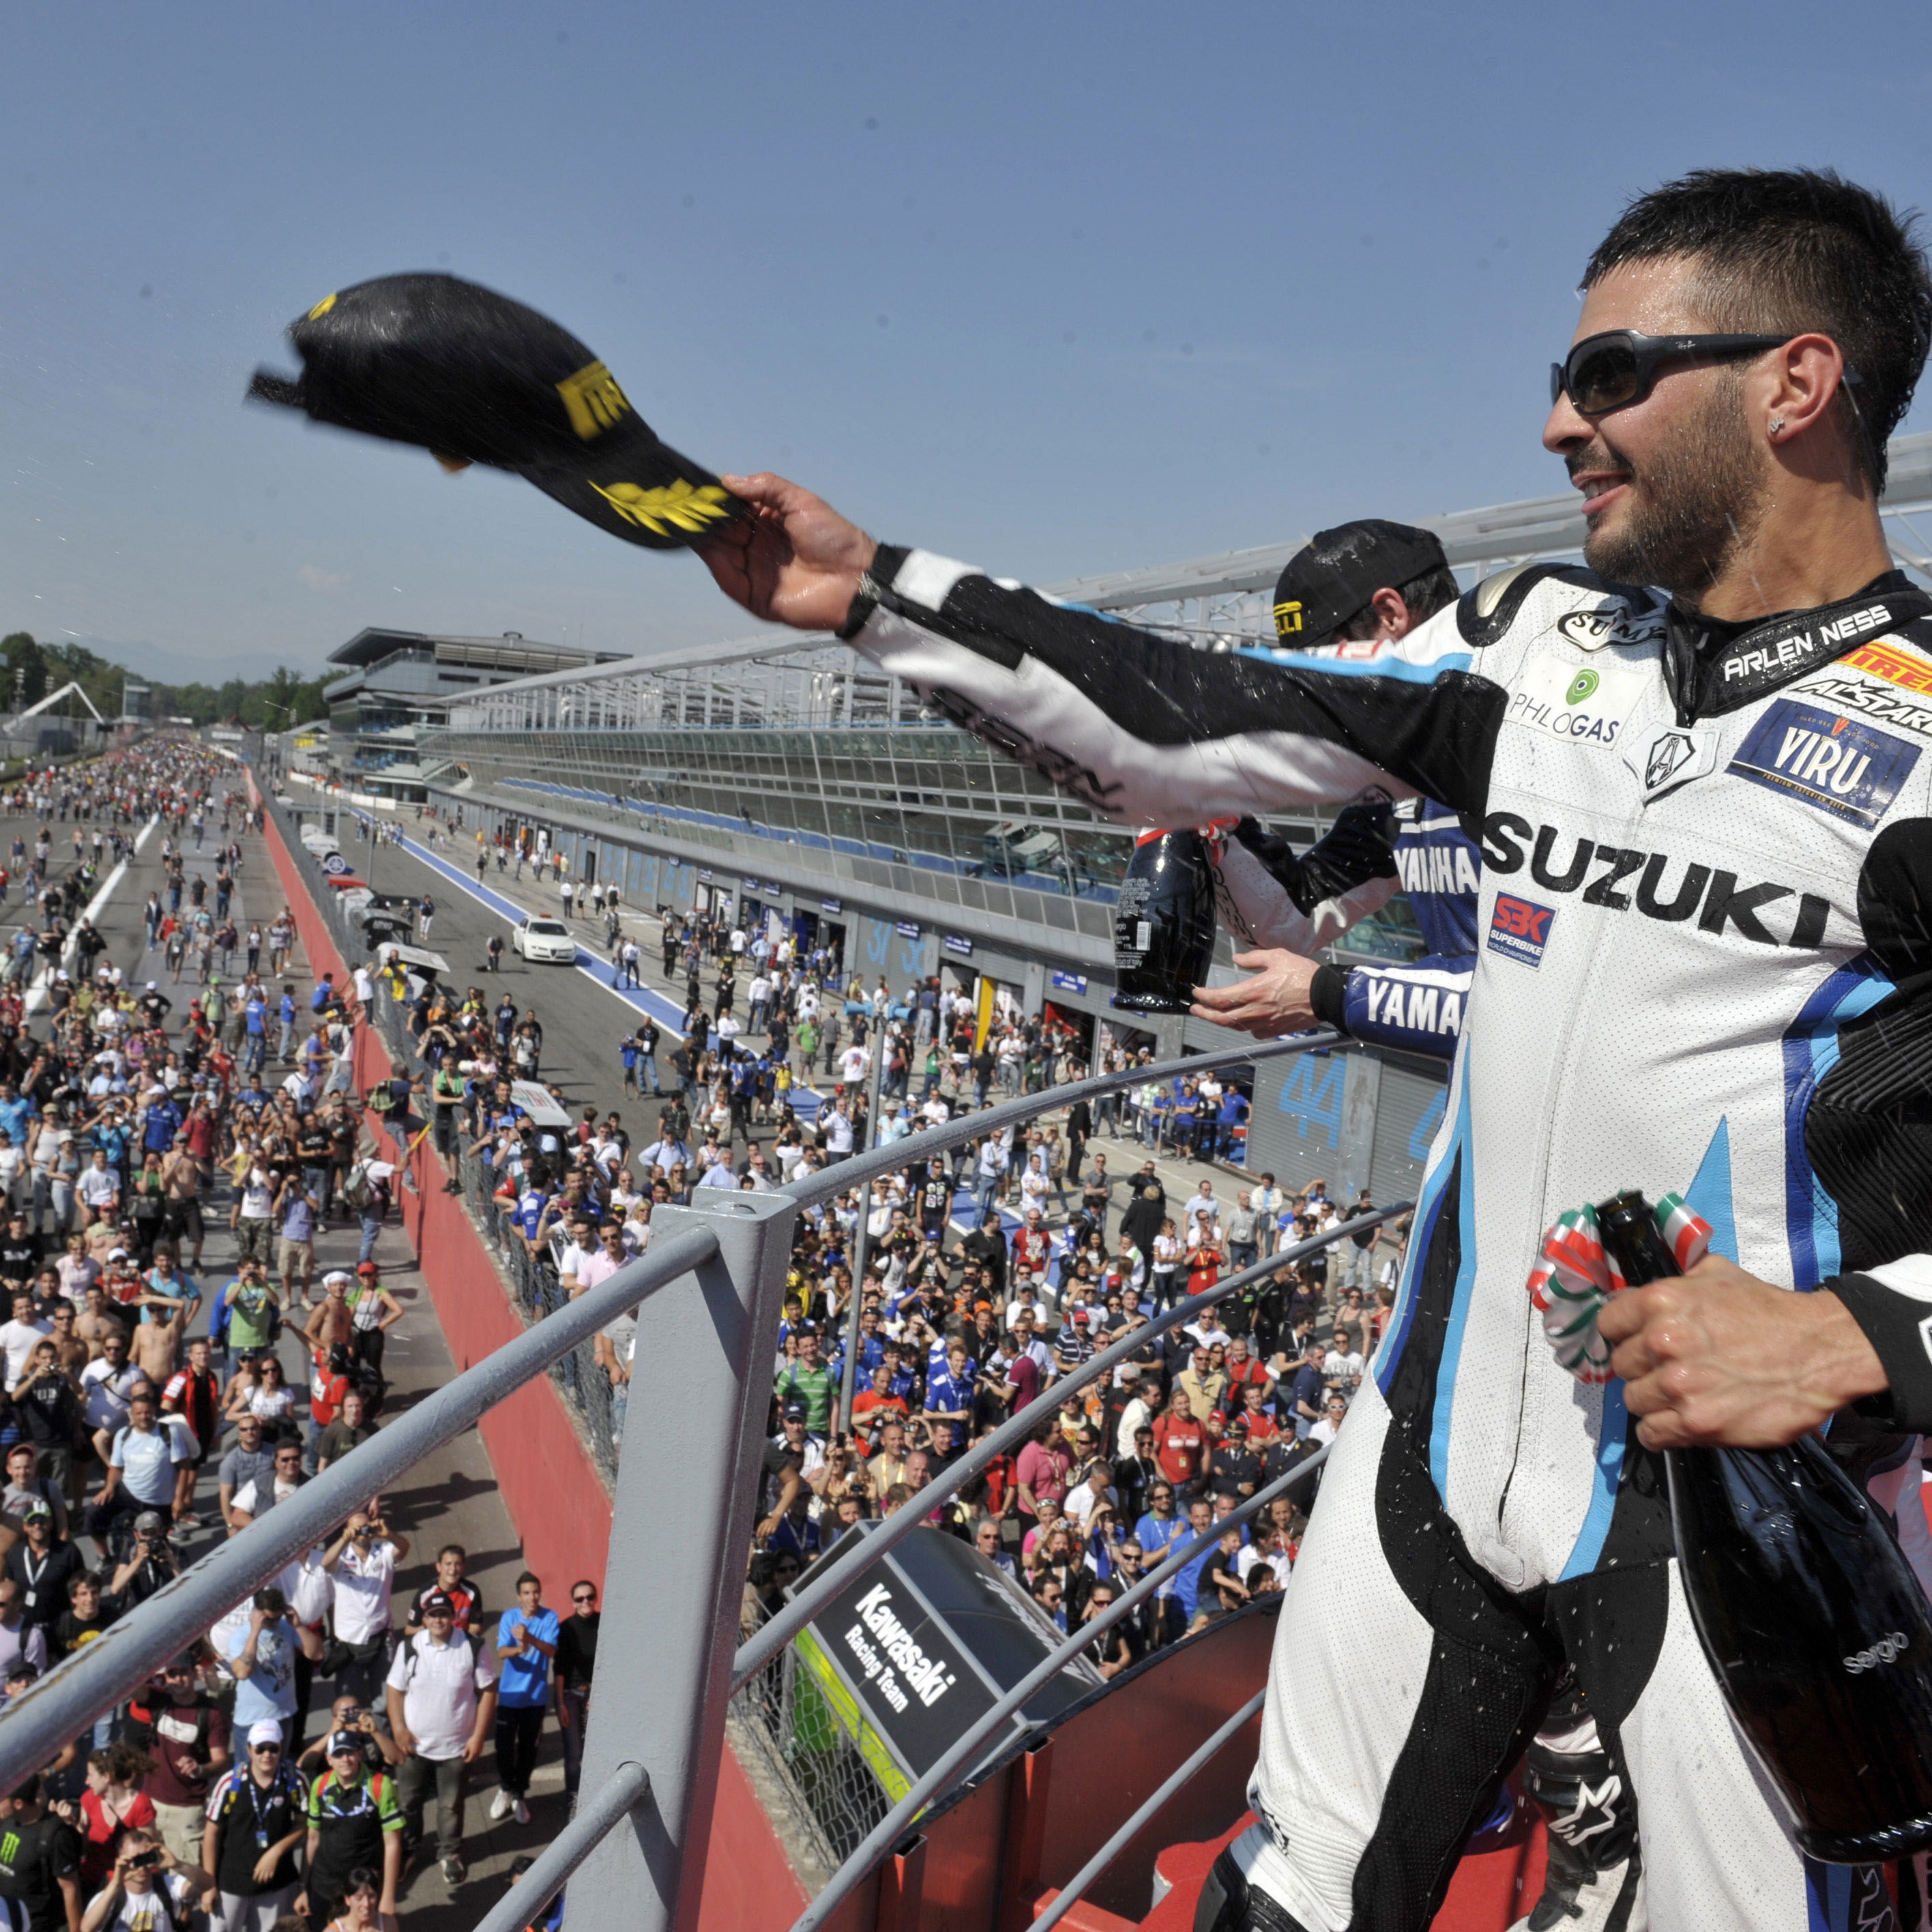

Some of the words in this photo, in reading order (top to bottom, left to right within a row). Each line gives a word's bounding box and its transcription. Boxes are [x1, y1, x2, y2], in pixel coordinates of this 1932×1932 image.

[1724, 632, 1813, 682] ARLEN
[1819, 604, 1892, 645] NESS
[1510, 694, 1620, 743] PHLOGAS
[1763, 773, 1792, 788] PREMIUM
[1774, 727, 1871, 795] VIRU
[1481, 811, 1830, 948] SUZUKI
[1490, 929, 1544, 956] SUPERBIKE
[1493, 897, 1551, 943] SBK
[1278, 1052, 1347, 1150] 44
[845, 1624, 883, 1679] Racing
[876, 1666, 909, 1714] Team
[855, 1582, 956, 1708] Kawasaki
